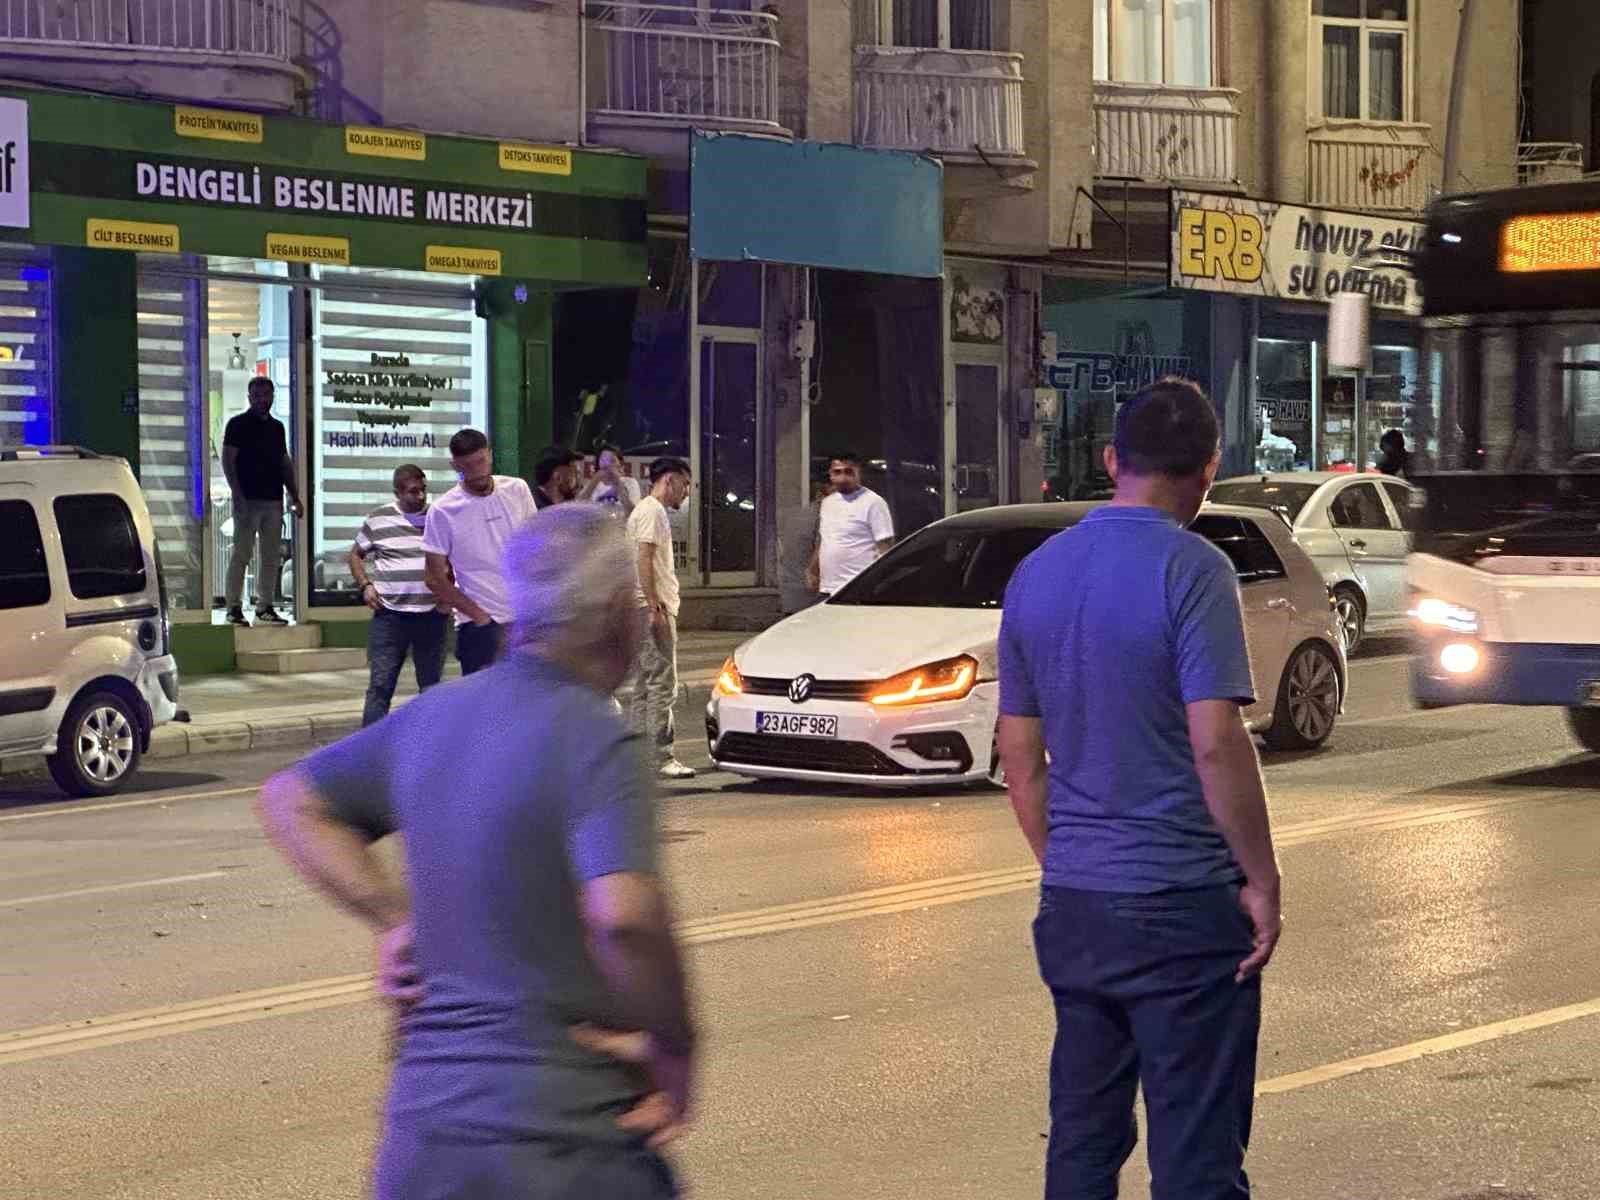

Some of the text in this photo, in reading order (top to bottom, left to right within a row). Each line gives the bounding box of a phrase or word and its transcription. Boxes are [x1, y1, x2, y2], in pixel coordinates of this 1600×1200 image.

[179, 114, 259, 135] PROTEİN TAKVİYESİ
[348, 132, 423, 151] KOLAJEN TAKVİYESİ
[503, 148, 531, 162] DETOKS
[136, 161, 533, 228] DENGELİ BESLENME MERKEZİ
[94, 227, 174, 247] CİLT BESLENMESİ
[1179, 207, 1264, 283] ERB
[1294, 215, 1374, 257] havuz
[269, 243, 346, 260] VEGAN BESLENME
[429, 255, 498, 270] OMEGA3 TAKVİYESİ
[1287, 264, 1320, 296] su
[371, 352, 410, 367] Burada
[329, 427, 436, 448] Hadi İlk Adımı At
